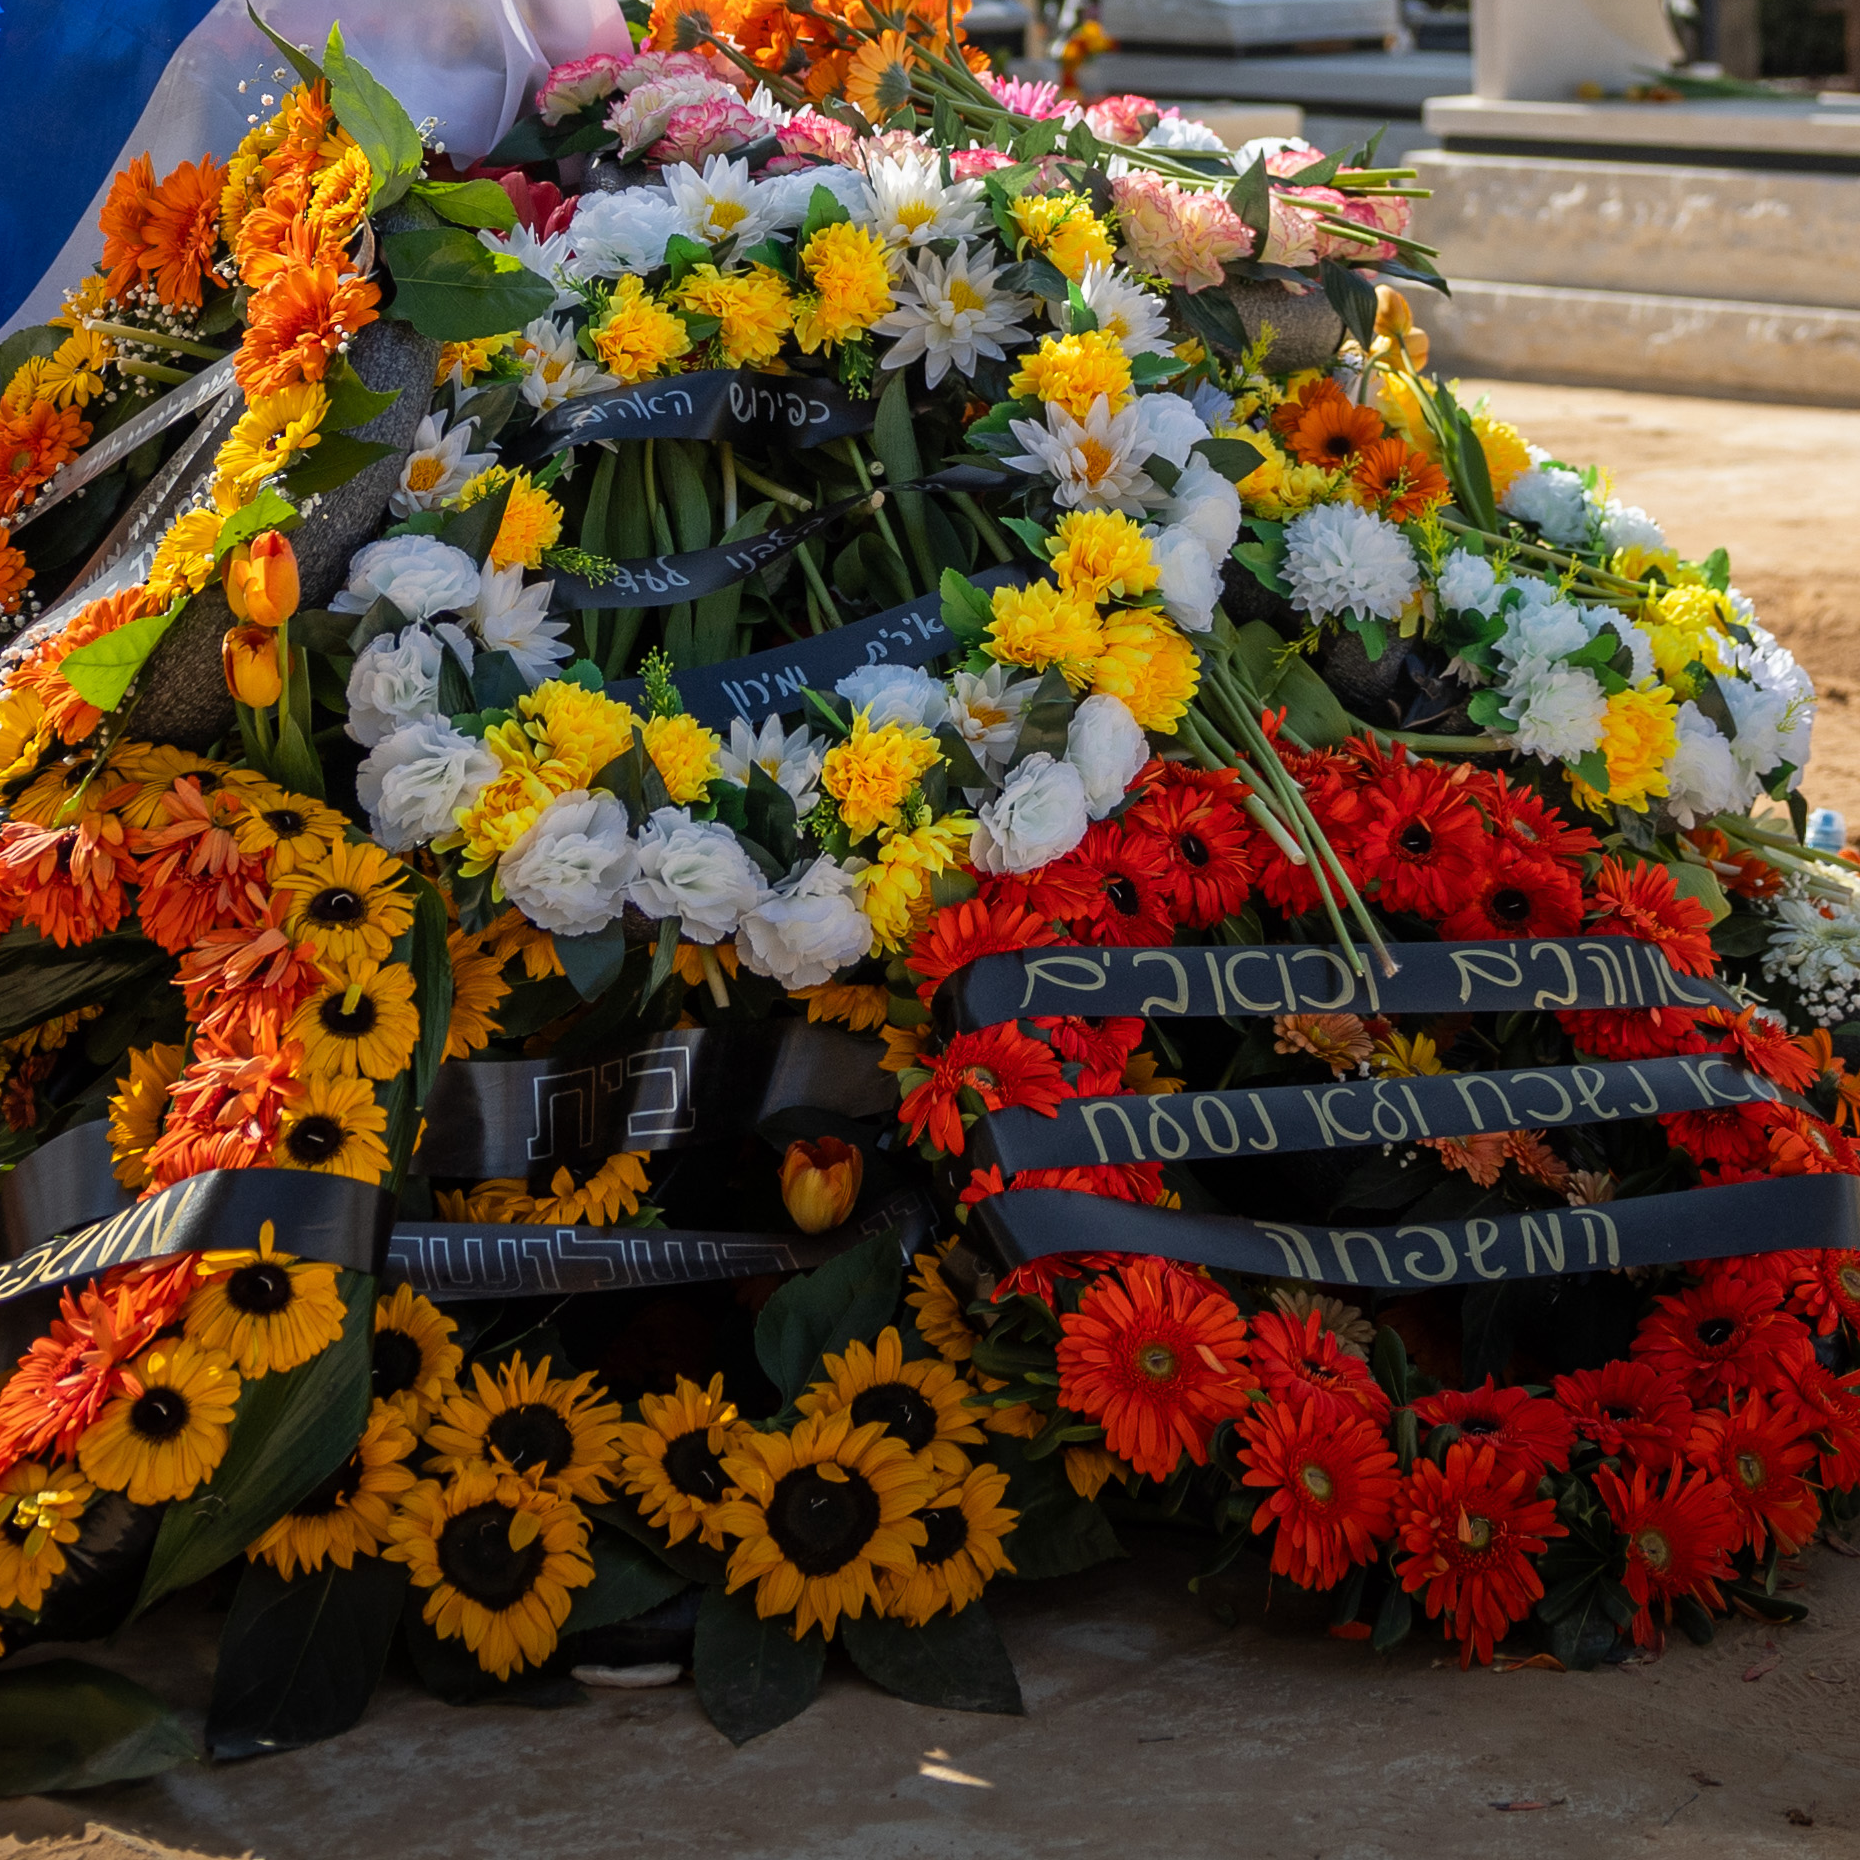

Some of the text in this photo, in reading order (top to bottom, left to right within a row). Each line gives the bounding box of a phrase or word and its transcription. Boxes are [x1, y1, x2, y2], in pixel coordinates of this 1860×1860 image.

[720, 612, 946, 728] אירית ומירון
[1019, 940, 1711, 1015] אוהבים וכואבים
[526, 1045, 697, 1161] בית
[1080, 1091, 1279, 1164] נסלח
[1302, 1079, 1431, 1148] ולא
[1455, 1064, 1660, 1132] נשכח
[1252, 1207, 1621, 1285] המשפחה
